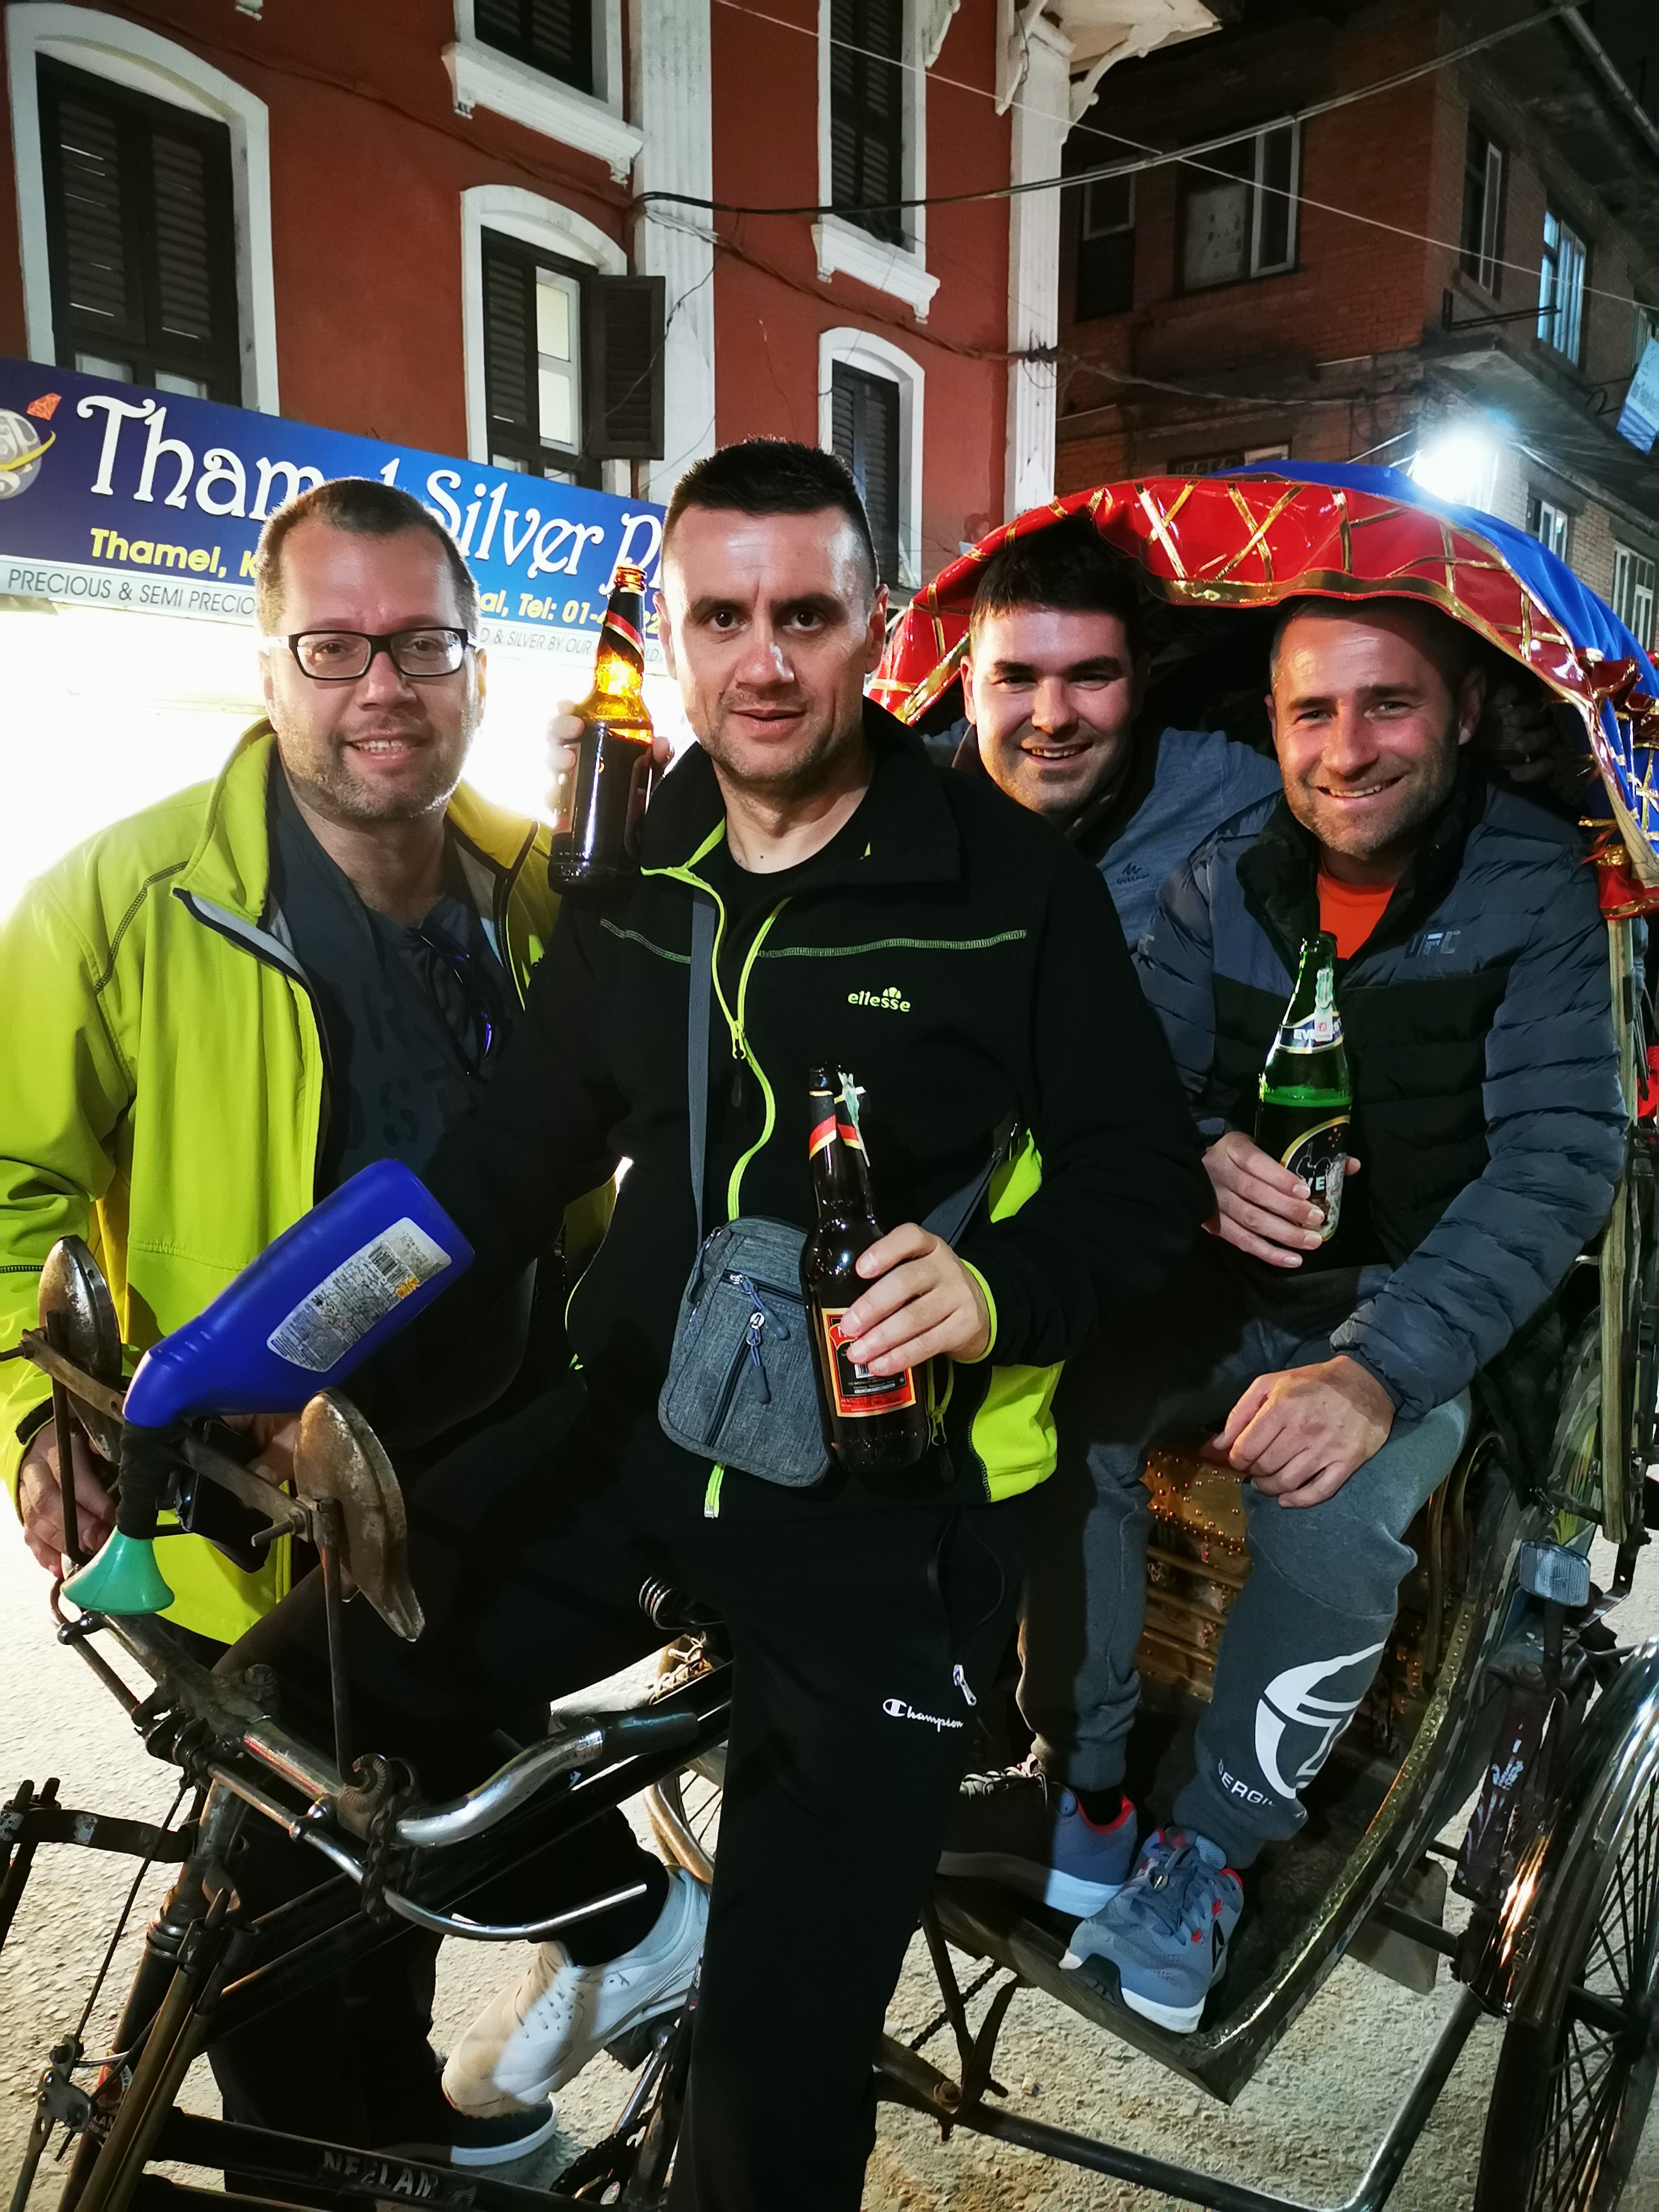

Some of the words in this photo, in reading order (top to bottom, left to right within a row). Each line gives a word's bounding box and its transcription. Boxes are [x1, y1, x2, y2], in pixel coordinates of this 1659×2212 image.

[426, 469, 605, 578] Silver
[90, 528, 227, 578] Thamel,
[518, 593, 557, 620] Tel:
[8, 569, 111, 599] PRECIOUS
[118, 583, 132, 601] &
[139, 587, 183, 608] SEMI
[189, 591, 255, 615] PRECIO
[494, 630, 503, 645] &
[507, 631, 545, 649] SILVER
[548, 635, 561, 651] BY
[566, 638, 592, 654] OUR
[1404, 930, 1461, 959] UFC
[848, 991, 911, 1012] ellesse
[883, 1698, 964, 1732] Champion
